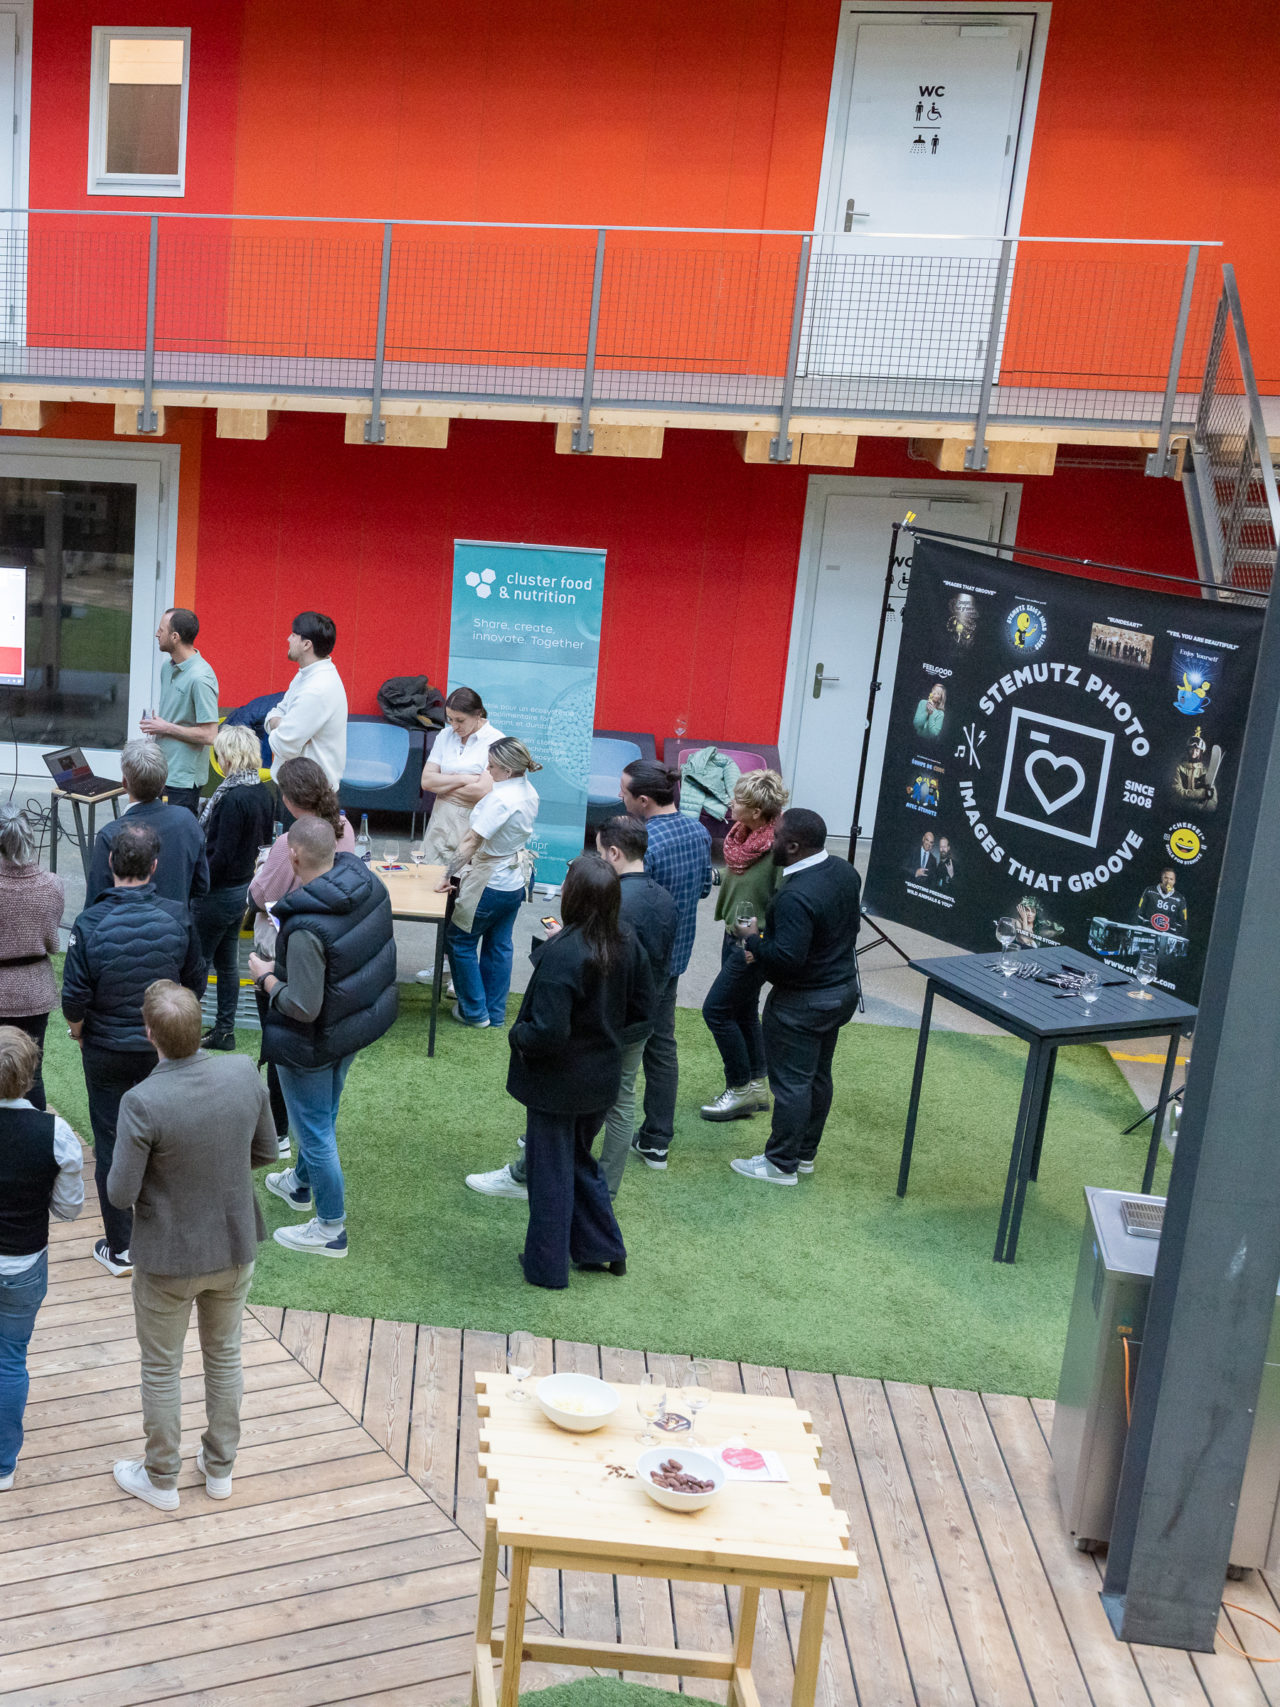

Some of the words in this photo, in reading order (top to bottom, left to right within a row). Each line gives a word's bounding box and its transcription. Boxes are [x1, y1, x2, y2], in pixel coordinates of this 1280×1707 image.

[919, 86, 945, 97] WC
[506, 572, 558, 588] cluster
[560, 576, 592, 590] food
[499, 586, 509, 599] &
[514, 589, 576, 604] nutrition
[531, 636, 585, 649] Together
[978, 662, 1082, 716] STEMUTZ
[1084, 673, 1151, 758] PHOTO
[1123, 780, 1156, 798] SINCE
[1122, 791, 1152, 809] 2008
[959, 781, 1006, 863] IMAGES
[1007, 857, 1062, 893] THAT
[1067, 829, 1144, 893] GROOVE
[1157, 900, 1168, 911] 86
